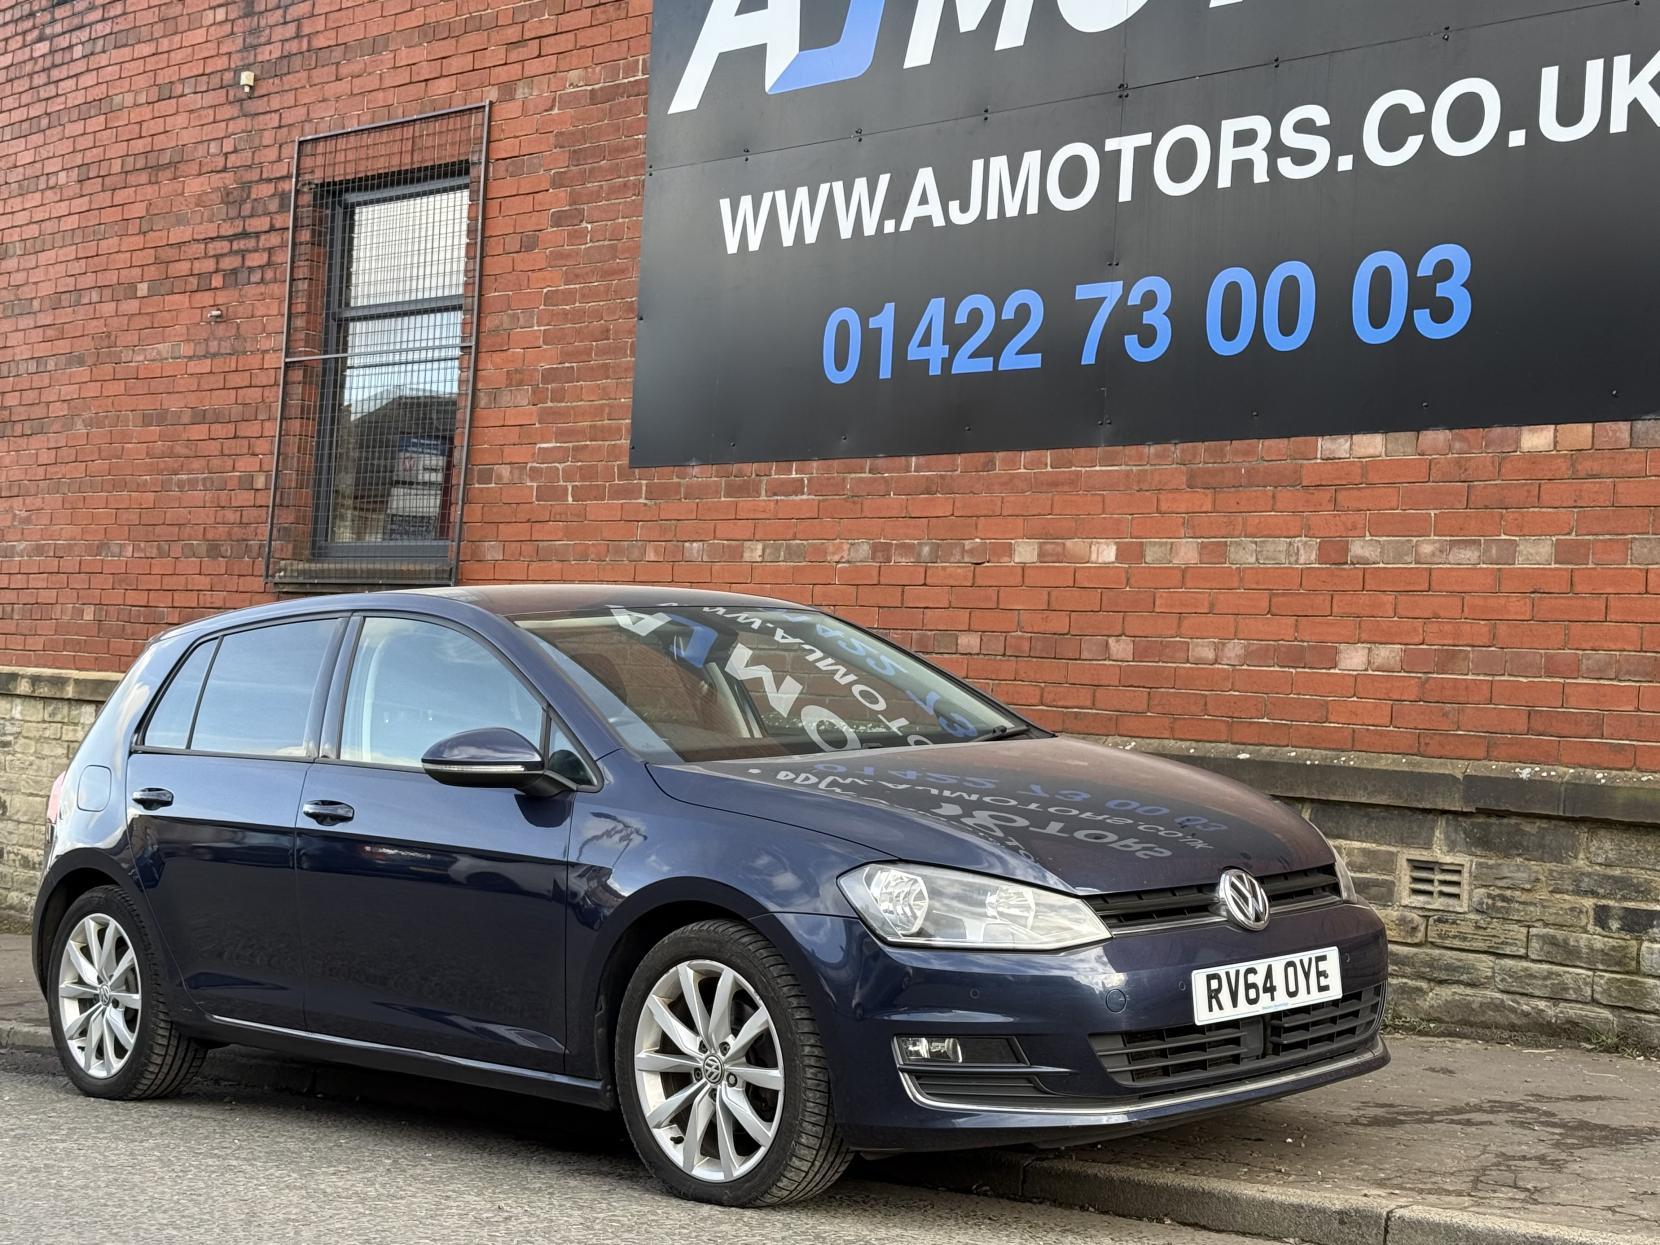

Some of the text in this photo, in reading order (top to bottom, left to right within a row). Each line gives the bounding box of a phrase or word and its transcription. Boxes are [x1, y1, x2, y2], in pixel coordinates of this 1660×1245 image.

[719, 50, 1660, 255] WWW.AJMOTORS.CO.UK
[822, 243, 1472, 384] 01422 73 00 03
[1206, 955, 1330, 1012] RV64 OYE
